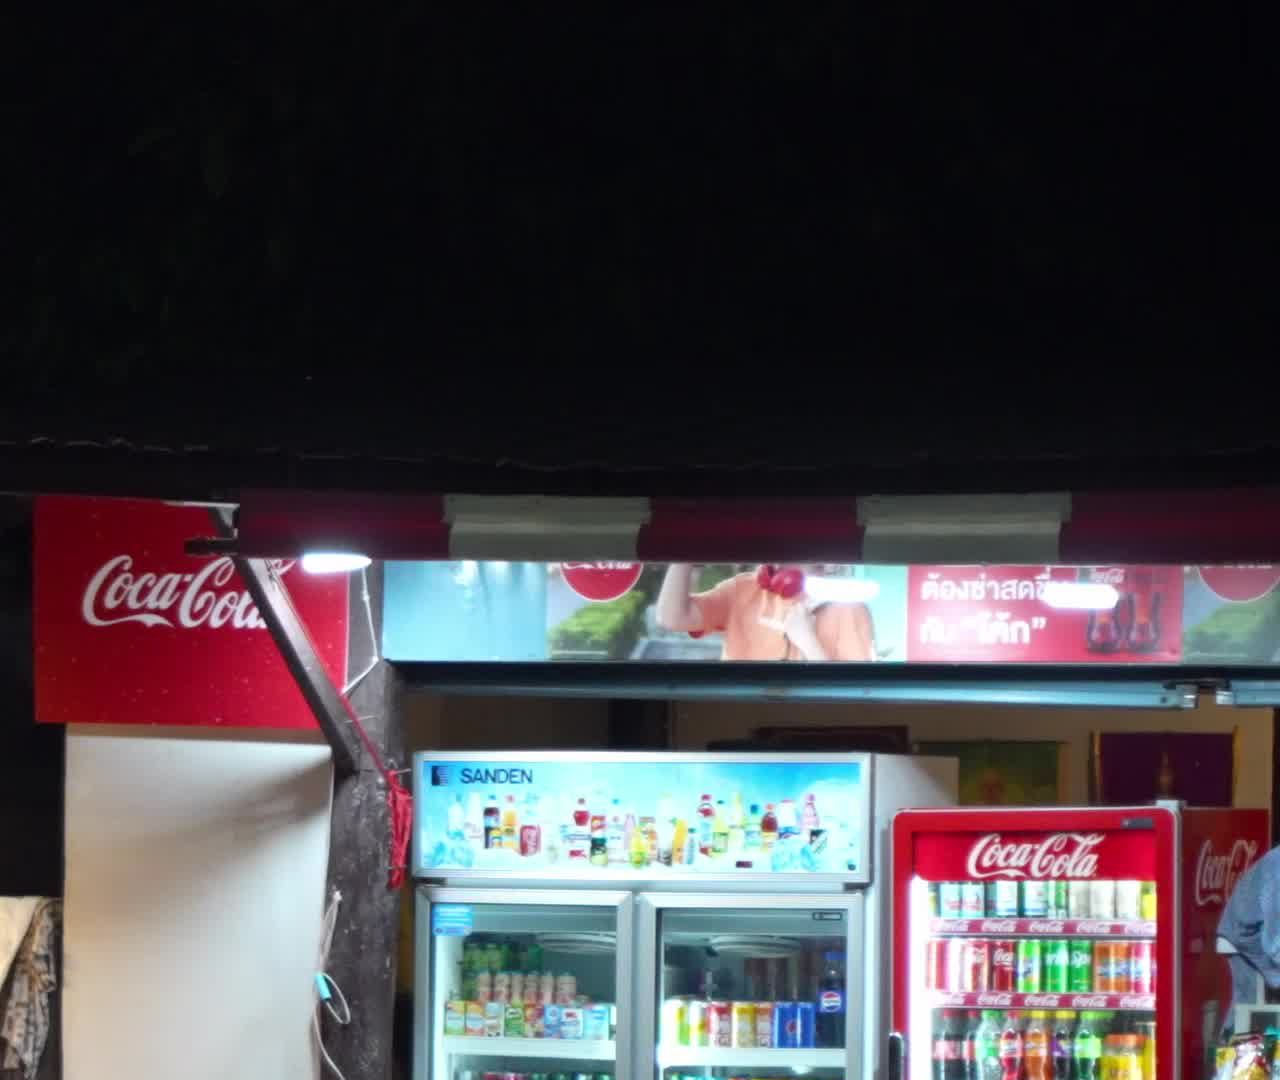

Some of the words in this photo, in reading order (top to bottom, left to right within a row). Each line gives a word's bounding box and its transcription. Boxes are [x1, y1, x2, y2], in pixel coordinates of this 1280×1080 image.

[82, 555, 272, 629] Coca-Col
[460, 768, 533, 785] SANDEN
[967, 833, 1105, 879] Coca-Cola
[1196, 839, 1259, 907] Coca-C
